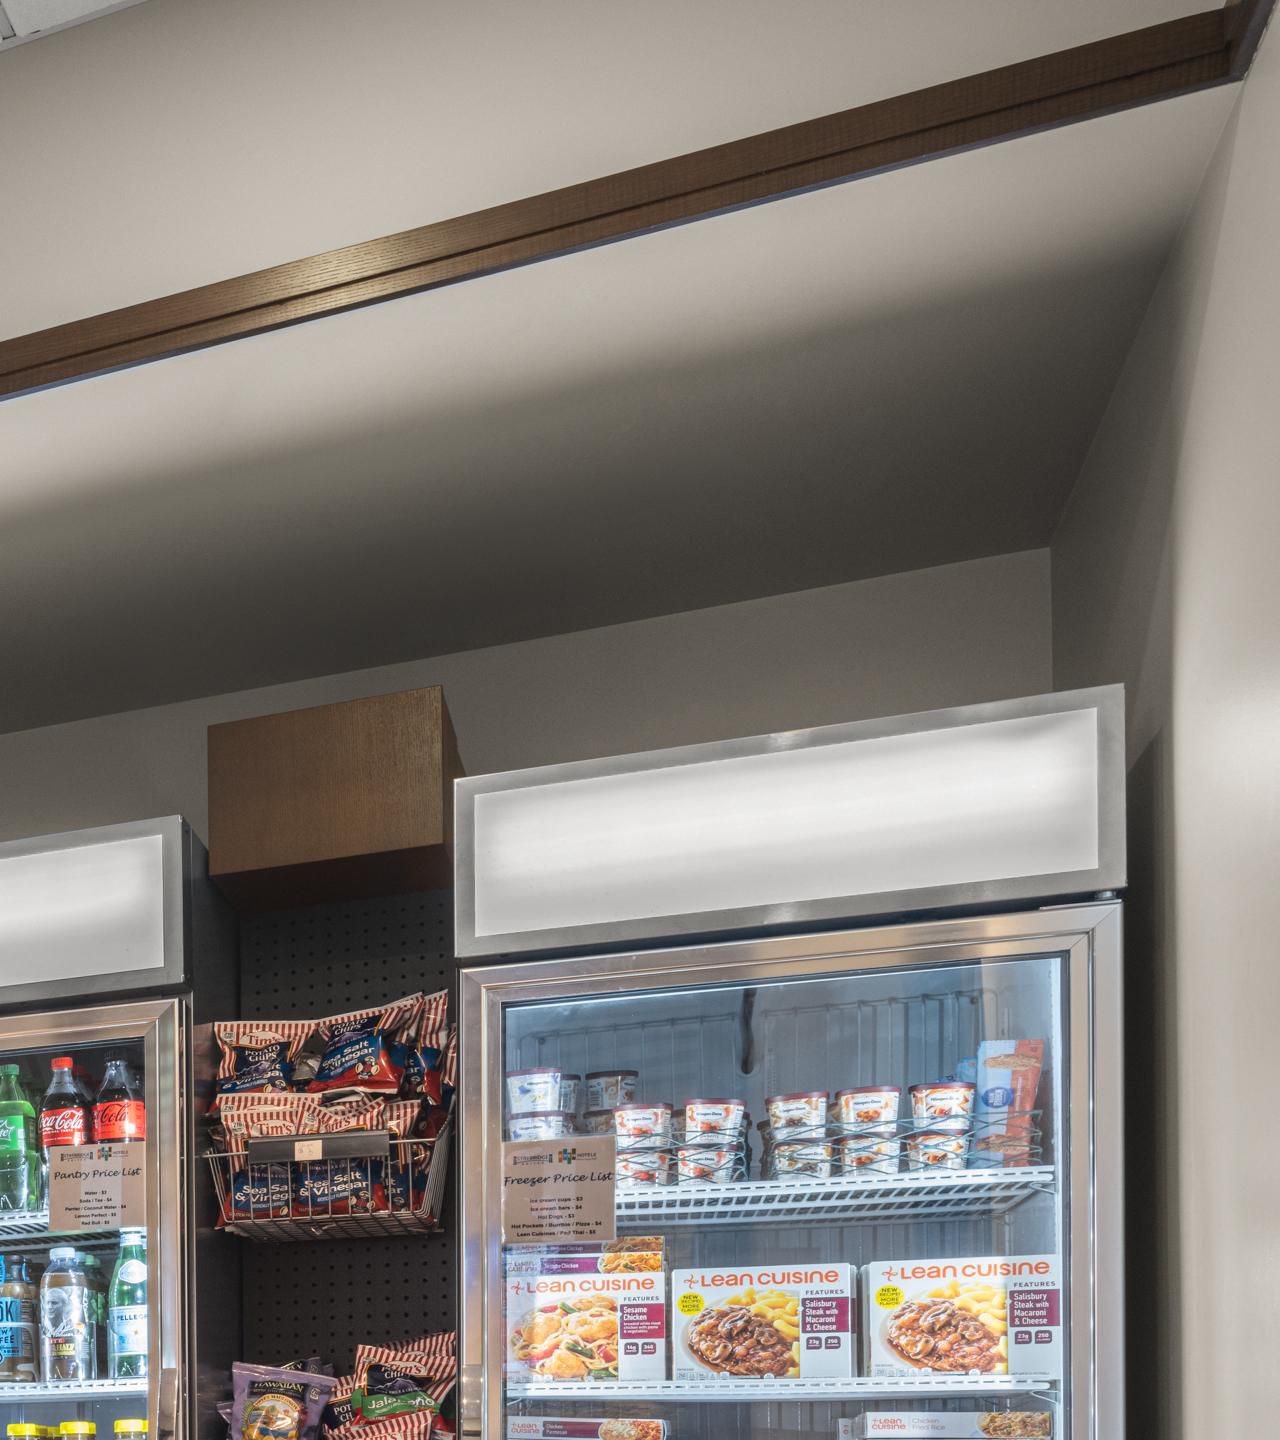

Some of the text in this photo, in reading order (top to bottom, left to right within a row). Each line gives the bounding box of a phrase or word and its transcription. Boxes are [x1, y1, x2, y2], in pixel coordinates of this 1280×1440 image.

[332, 1019, 368, 1030] POTATO
[343, 1040, 369, 1054] Salt
[256, 1122, 291, 1136] Tim's
[54, 1168, 141, 1180] Pantry Price List
[334, 1172, 362, 1184] Salt
[504, 1172, 614, 1187] Freezer Price List
[311, 1180, 369, 1196] Vinegar
[1014, 1293, 1047, 1301] Salisbury
[806, 1300, 836, 1308] Salisbury
[1022, 1317, 1047, 1325] Cheese
